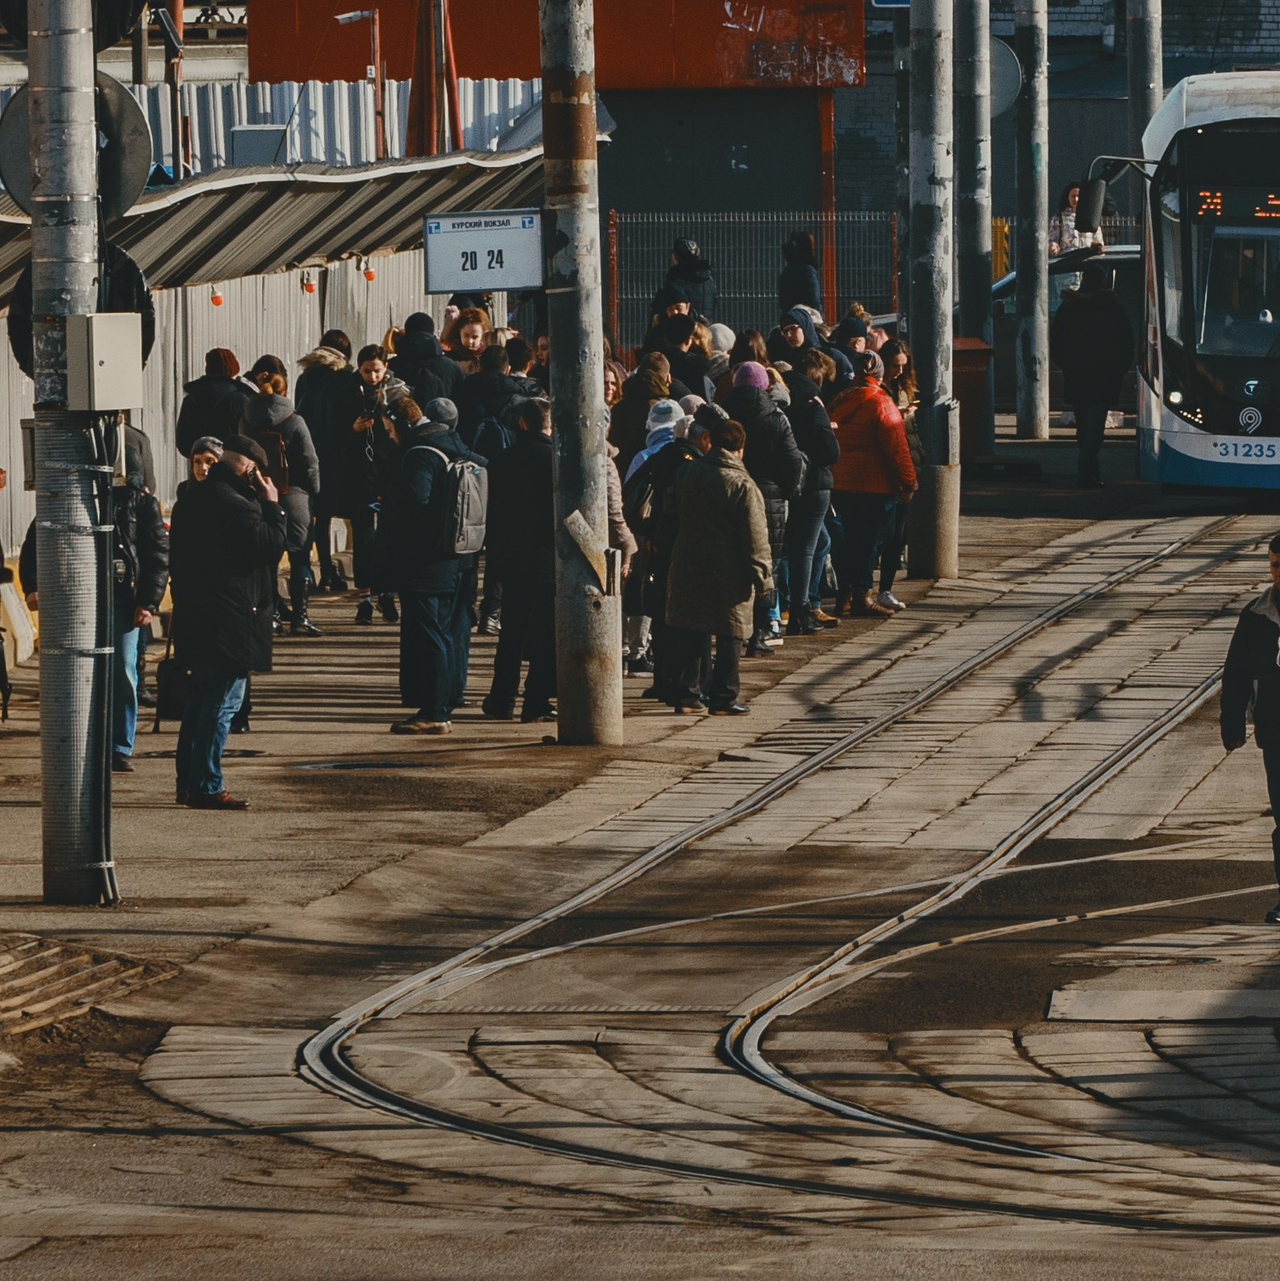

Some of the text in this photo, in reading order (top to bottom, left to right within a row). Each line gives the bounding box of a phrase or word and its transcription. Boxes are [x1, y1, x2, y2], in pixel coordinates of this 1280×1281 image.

[1198, 192, 1221, 216] 24
[452, 221, 482, 229] КУРСКИЙ
[484, 219, 510, 228] ВОКЗАЛ
[461, 249, 504, 271] 20 24
[1219, 443, 1277, 458] 31235
